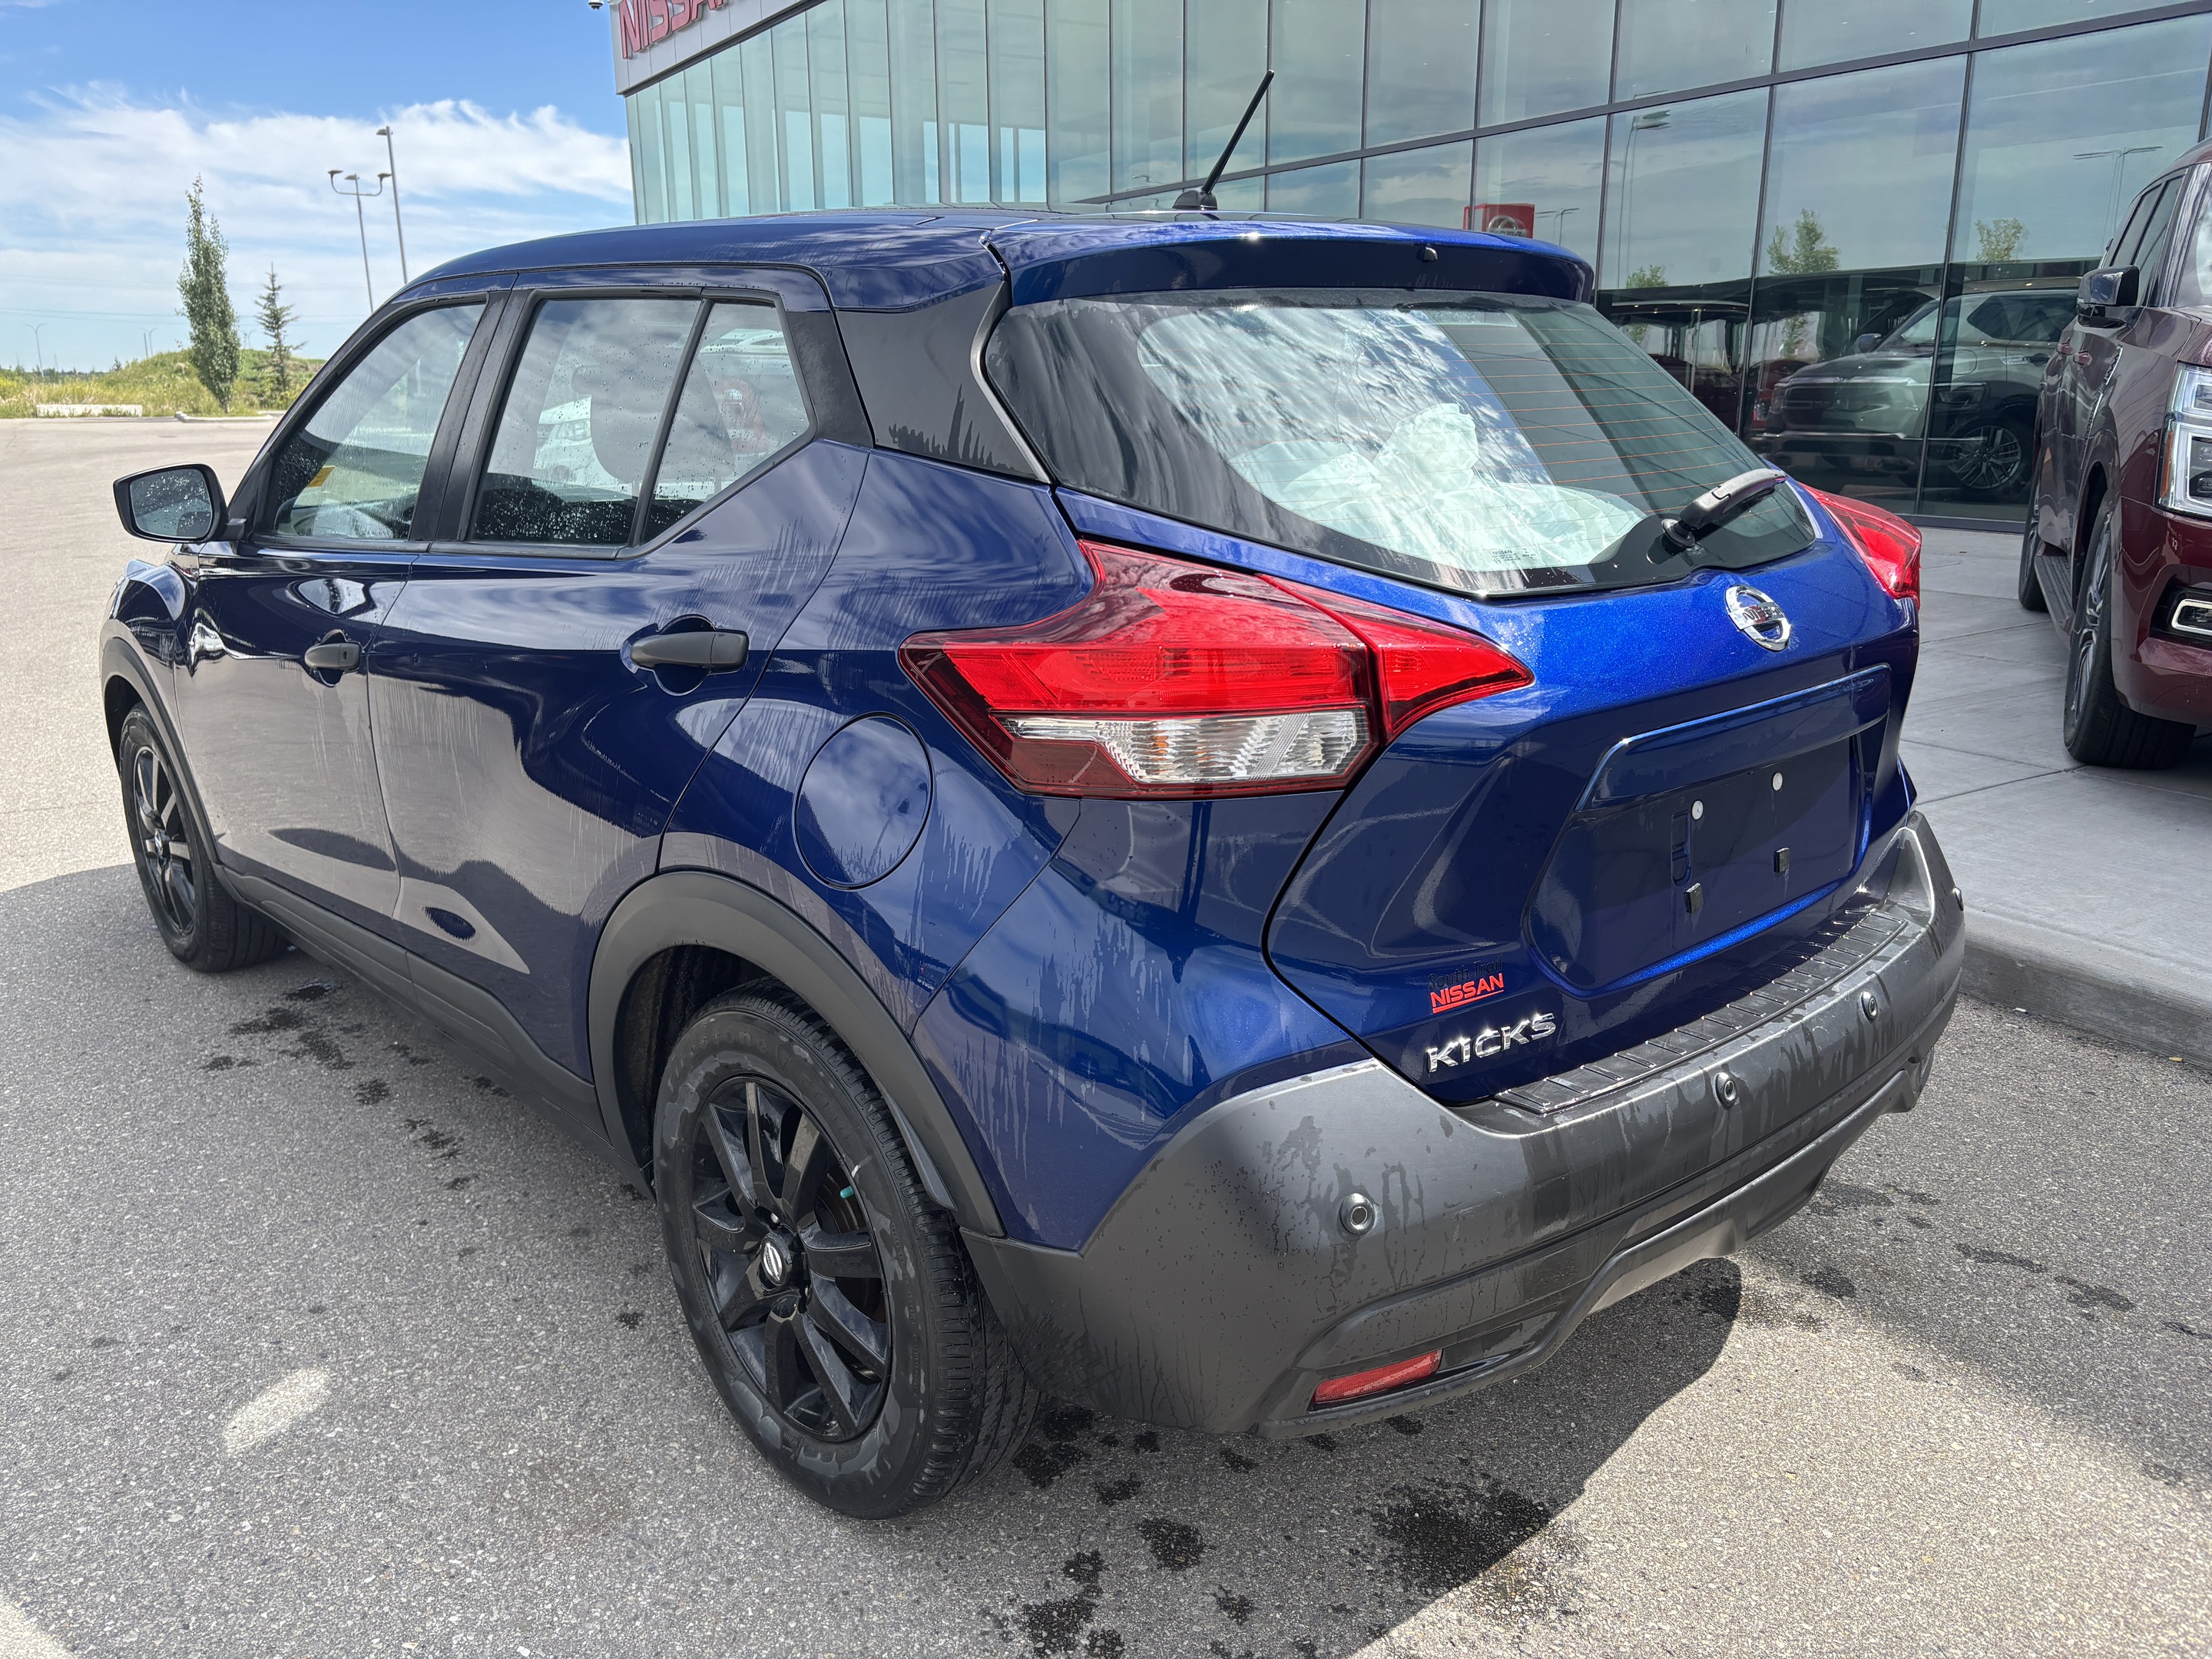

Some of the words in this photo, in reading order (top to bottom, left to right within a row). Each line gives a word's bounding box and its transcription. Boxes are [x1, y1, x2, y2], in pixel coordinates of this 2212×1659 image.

[618, 0, 724, 59] NISS
[1428, 965, 1469, 990] South
[1473, 956, 1502, 979] Trail
[1430, 972, 1505, 1008] NISSAN
[1426, 1012, 1557, 1074] KICKS
